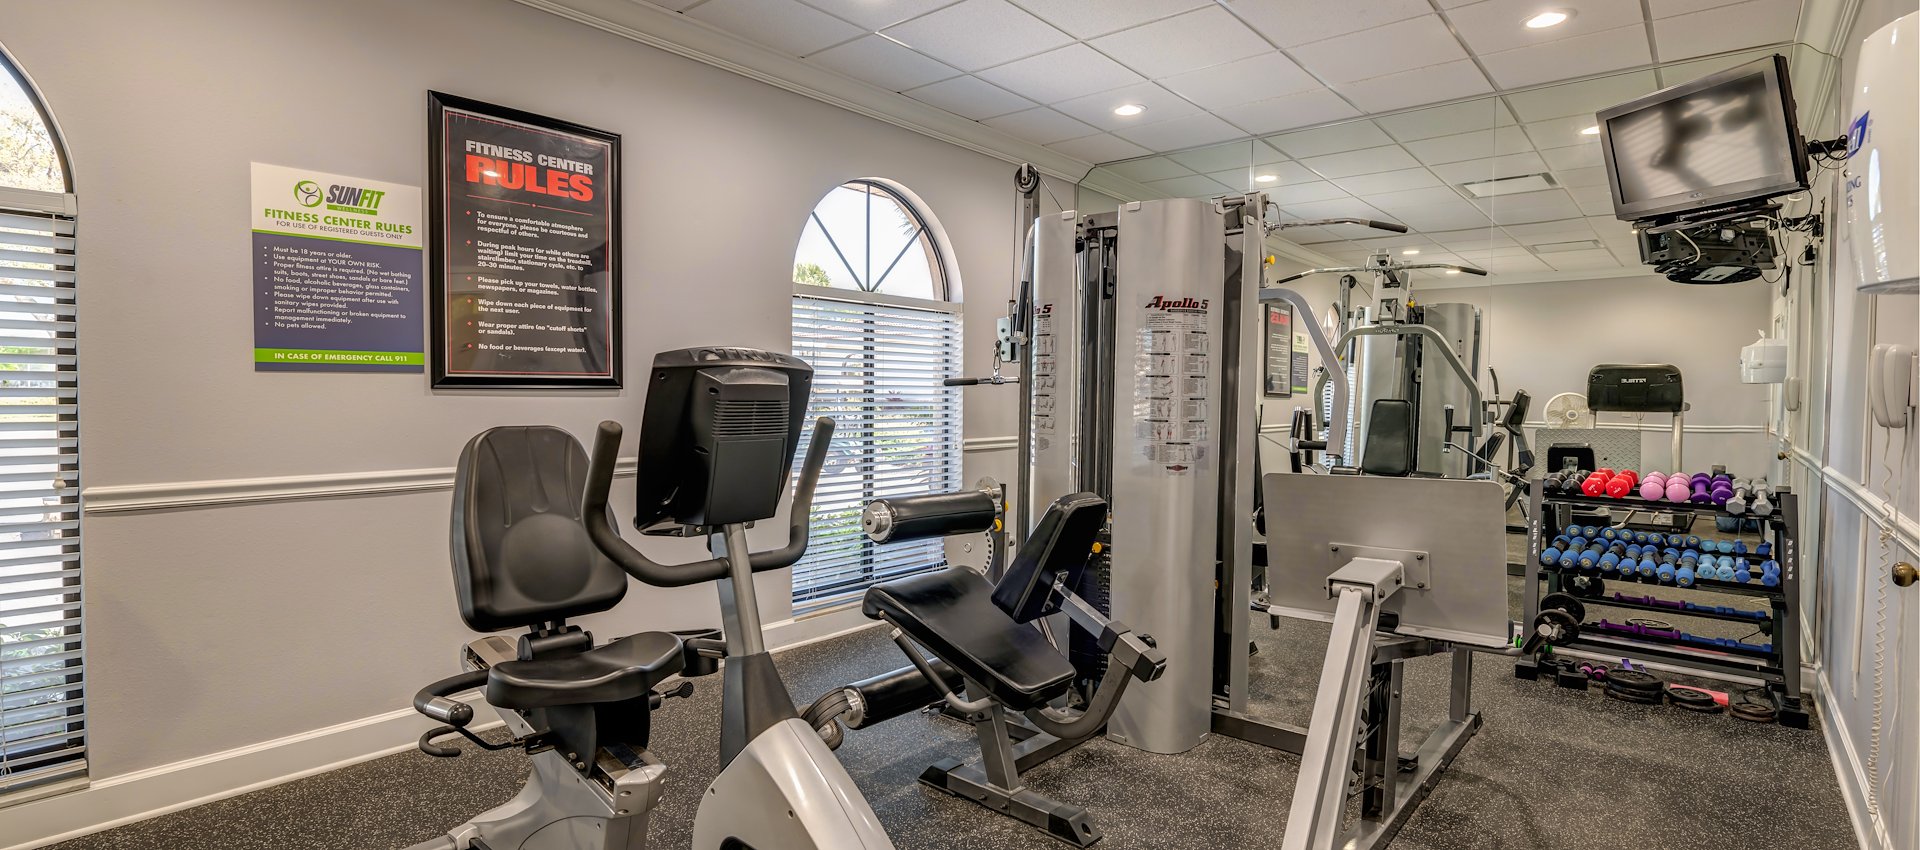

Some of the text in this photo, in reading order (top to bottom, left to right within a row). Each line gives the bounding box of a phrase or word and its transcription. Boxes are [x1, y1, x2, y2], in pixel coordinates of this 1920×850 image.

[466, 140, 593, 175] FITNESS CENTER
[466, 154, 594, 202] RULES
[326, 184, 385, 209] SUNFIT
[264, 208, 412, 234] FITNESS CENTER RULES
[515, 217, 550, 227] comfortable
[551, 222, 583, 232] atmosphere
[320, 226, 358, 234] REGISTERED
[478, 226, 509, 235] respectful
[488, 221, 518, 230] everyone,
[549, 229, 577, 237] courteous
[478, 241, 499, 249] During
[478, 248, 504, 256] waiting)
[567, 258, 592, 266] treadmill,
[478, 255, 516, 264] stairclimber,
[518, 259, 547, 268] stationary
[332, 280, 363, 289] beverages,
[1042, 304, 1052, 313] 5
[1145, 296, 1209, 310] Apollo 5
[297, 308, 340, 316] malfunctioning
